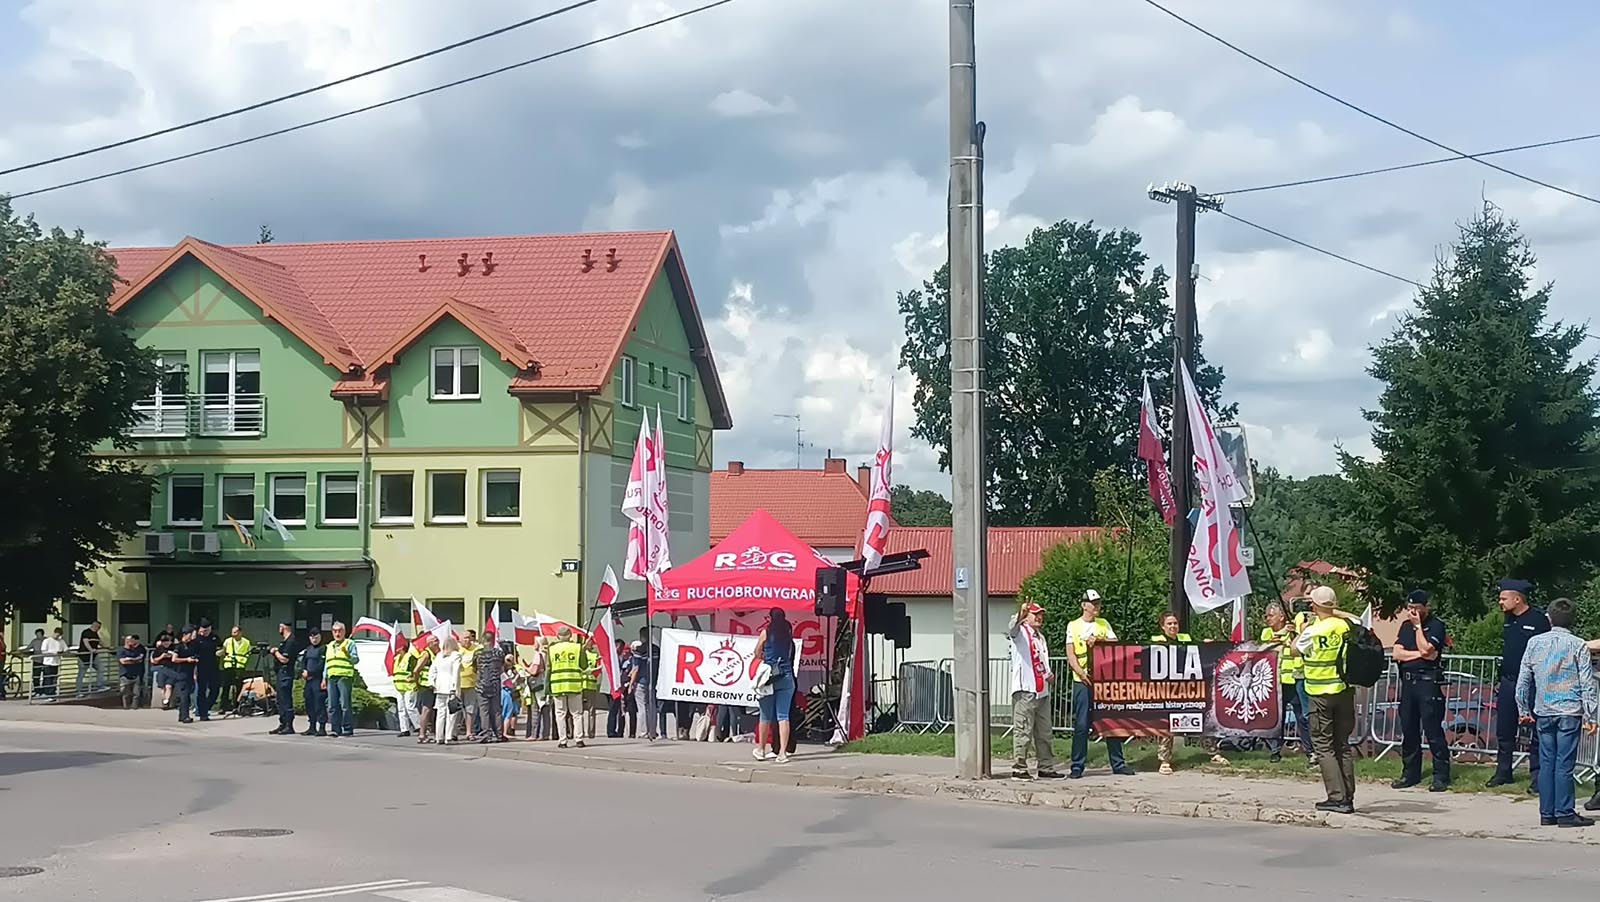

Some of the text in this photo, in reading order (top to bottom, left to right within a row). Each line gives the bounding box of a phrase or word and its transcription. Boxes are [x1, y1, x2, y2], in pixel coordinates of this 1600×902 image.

[687, 586, 816, 600] RUCHOBRONYGRAN
[1092, 645, 1203, 681] NIE DLA
[671, 687, 699, 698] RUCH
[702, 690, 744, 701] OBRONY
[1094, 681, 1206, 701] REGERMANIZACJI
